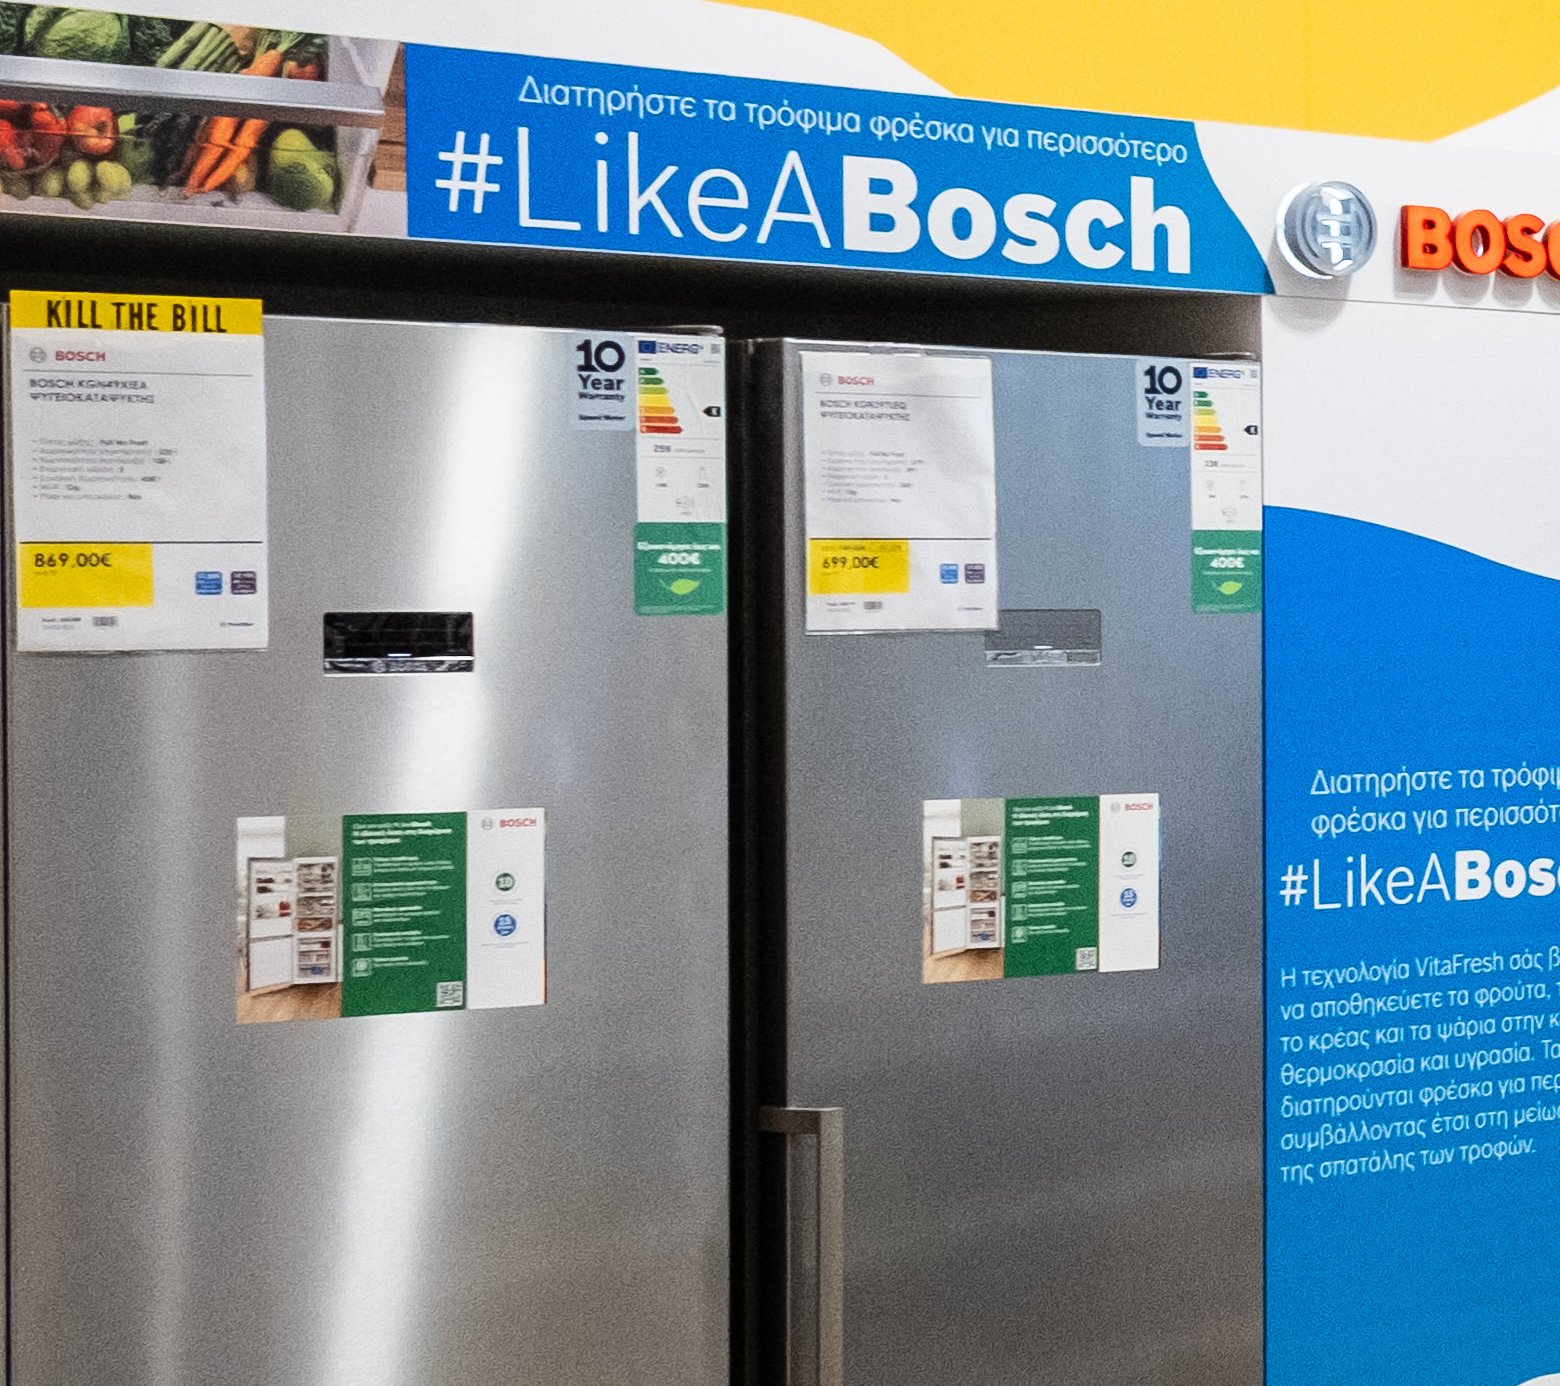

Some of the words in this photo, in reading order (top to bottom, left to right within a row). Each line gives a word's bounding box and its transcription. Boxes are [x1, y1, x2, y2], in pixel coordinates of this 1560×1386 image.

[518, 74, 699, 121] Διατηρήστε
[706, 97, 737, 122] τα
[743, 97, 863, 137] τρόφιμα
[868, 109, 977, 148] φρέσκα
[981, 124, 1020, 153] για
[1025, 125, 1189, 168] περισσότερο
[434, 126, 1192, 275] #LikeABosch
[46, 299, 103, 329] KILL
[111, 302, 159, 332] THE
[172, 304, 228, 334] BILL
[55, 349, 106, 363] BOSCH
[576, 338, 626, 373] 10
[578, 373, 625, 392] Year
[837, 375, 875, 387] BOSCH
[1144, 364, 1183, 395] 10
[1145, 395, 1182, 412] Year
[1310, 765, 1454, 798] Διατηρήστε
[1457, 767, 1486, 790] τα
[498, 817, 538, 829] BOSCH
[1123, 801, 1154, 812] BOSCH
[1310, 806, 1408, 840] φρέσκα
[1412, 808, 1449, 835] για
[1301, 958, 1411, 990] τεχνολογία
[1414, 951, 1505, 978] VitaFresh
[1509, 949, 1544, 973] σάς
[1280, 1003, 1305, 1021] να
[1310, 989, 1444, 1019] αποθηκεύετε
[1448, 989, 1469, 1006] τα
[1280, 1035, 1304, 1054] το
[1308, 1026, 1370, 1054] κρέας
[1376, 1027, 1405, 1045] και
[1410, 1023, 1432, 1042] τα
[1437, 1016, 1496, 1043] ψάρια
[1501, 1014, 1546, 1035] στην
[1280, 1053, 1415, 1088] θερμοκρασία
[1420, 1054, 1450, 1072] και
[1454, 1041, 1535, 1071] υγρασία.
[1280, 1088, 1415, 1119] διατηρούνται
[1418, 1079, 1493, 1107] φρέσκα
[1498, 1077, 1526, 1100] για
[1280, 1119, 1427, 1153] συμβάλλοντας
[1431, 1112, 1470, 1134] έτσι
[1474, 1110, 1509, 1131] στη
[1280, 1163, 1314, 1186] της
[1319, 1149, 1416, 1179] σπατάλης
[1419, 1147, 1455, 1166] των
[1459, 1135, 1537, 1164] τροφών.
